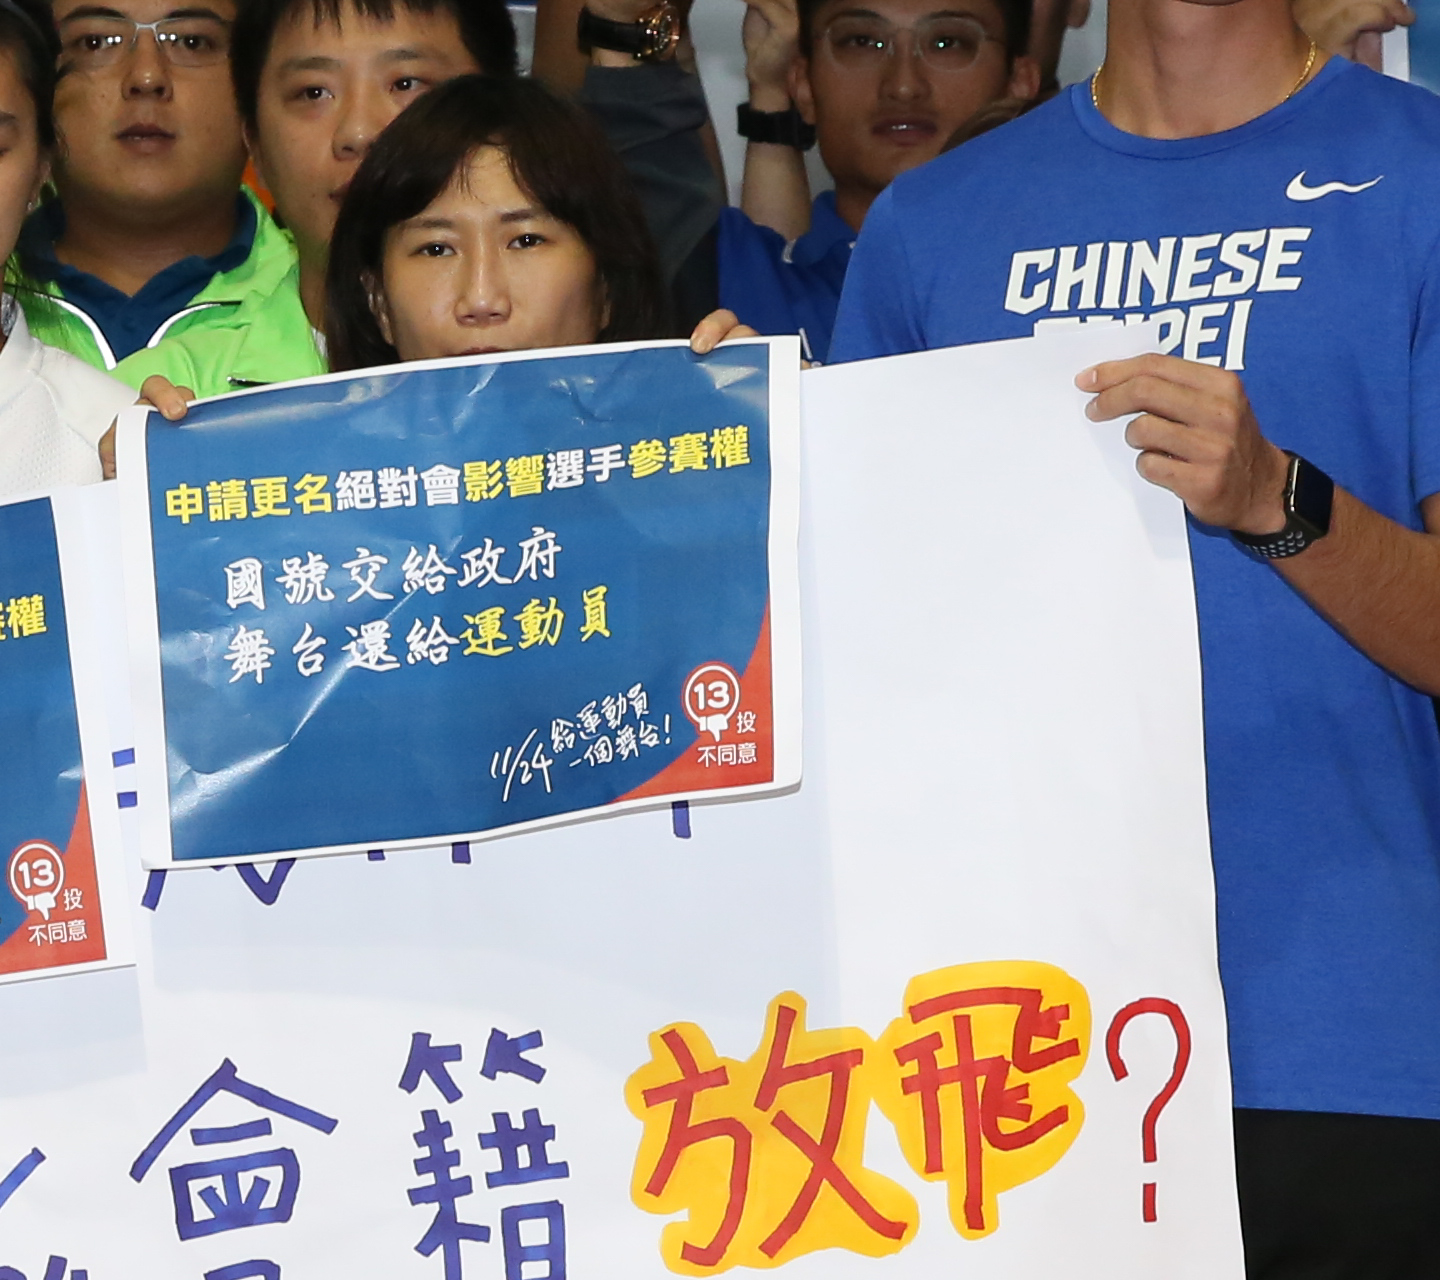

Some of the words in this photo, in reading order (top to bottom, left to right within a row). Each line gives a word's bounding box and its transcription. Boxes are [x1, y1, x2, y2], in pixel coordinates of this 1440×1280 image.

[1004, 226, 1313, 315] CHINESE
[164, 426, 751, 526] 申請更名絕對會影響選手參賽權
[223, 526, 562, 611] 國號交給政府
[223, 585, 612, 685] 舞台還給運動員
[549, 683, 651, 753] 給運動員
[693, 681, 731, 710] 13
[736, 710, 756, 734] 投
[489, 729, 552, 802] 11/24
[697, 740, 758, 768] 不同意
[18, 860, 55, 887] 13
[63, 888, 83, 911] 投
[28, 918, 87, 946] 不同意
